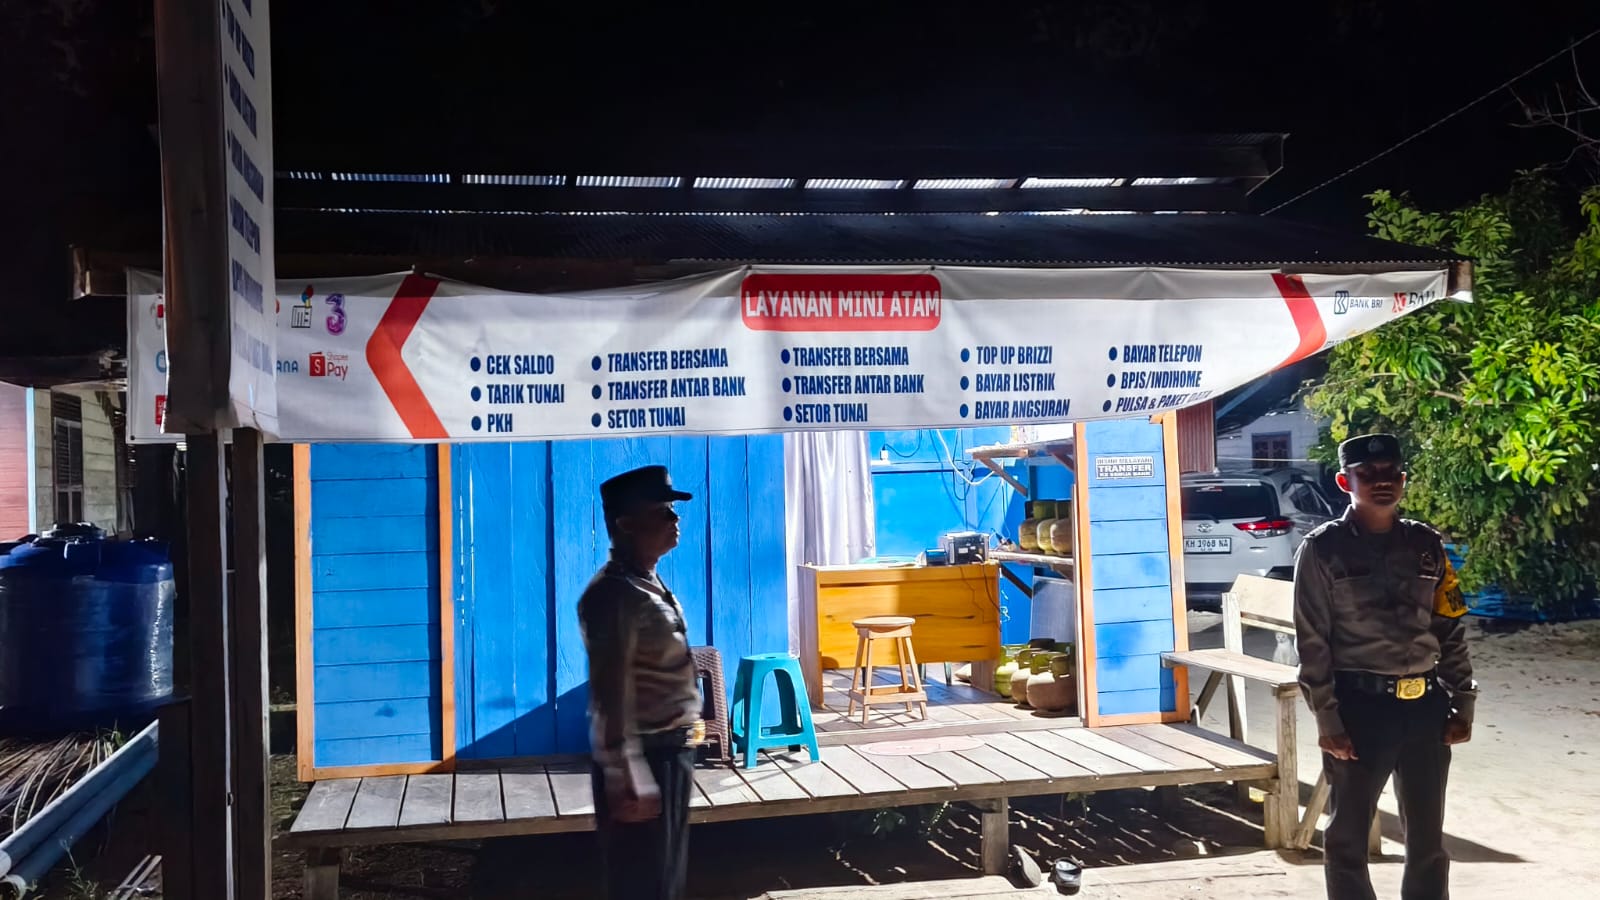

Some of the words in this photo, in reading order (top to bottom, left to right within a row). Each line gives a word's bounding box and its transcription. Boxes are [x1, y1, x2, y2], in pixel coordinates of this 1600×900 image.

[745, 290, 832, 318] LAYANAN
[838, 290, 884, 318] MINI
[890, 290, 940, 318] ATAM
[1349, 298, 1369, 309] BANK
[607, 350, 669, 373] TRANSFER
[670, 348, 729, 370] BERSAMA
[792, 347, 854, 367] TRANSFER
[854, 346, 909, 366] BERSAMA
[976, 346, 998, 365] TOP
[1000, 345, 1016, 364] UP
[1017, 345, 1053, 364] BRIZZI
[1122, 345, 1156, 363] BAYAR
[1158, 344, 1203, 363] TELEPON
[327, 361, 349, 381] Pay
[486, 354, 511, 375] CEK
[514, 354, 555, 375] SALDO
[607, 379, 669, 401] TRANSFER
[670, 378, 711, 399] ANTAR
[712, 376, 746, 397] BANK
[793, 375, 854, 395] TRANSFER
[854, 374, 891, 394] ANTAR
[894, 374, 925, 394] BANK
[975, 373, 1011, 392] BAYAR
[1013, 373, 1056, 391] LISTRIK
[1121, 370, 1203, 390] BPJS/INDIHOME
[486, 384, 525, 404] TARIK
[526, 383, 566, 403] TUNAI
[1115, 396, 1149, 412] PULSA
[1148, 398, 1157, 409] &
[1157, 393, 1189, 409] PAKET
[607, 408, 647, 429] SETOR
[648, 406, 687, 427] TUNAI
[795, 403, 831, 424] SETOR
[834, 403, 868, 423] TUNAI
[974, 400, 1010, 419] BAYAR
[1011, 398, 1071, 418] ANGSURAN
[487, 413, 514, 433] PKH
[1098, 464, 1152, 473] TRANSFER
